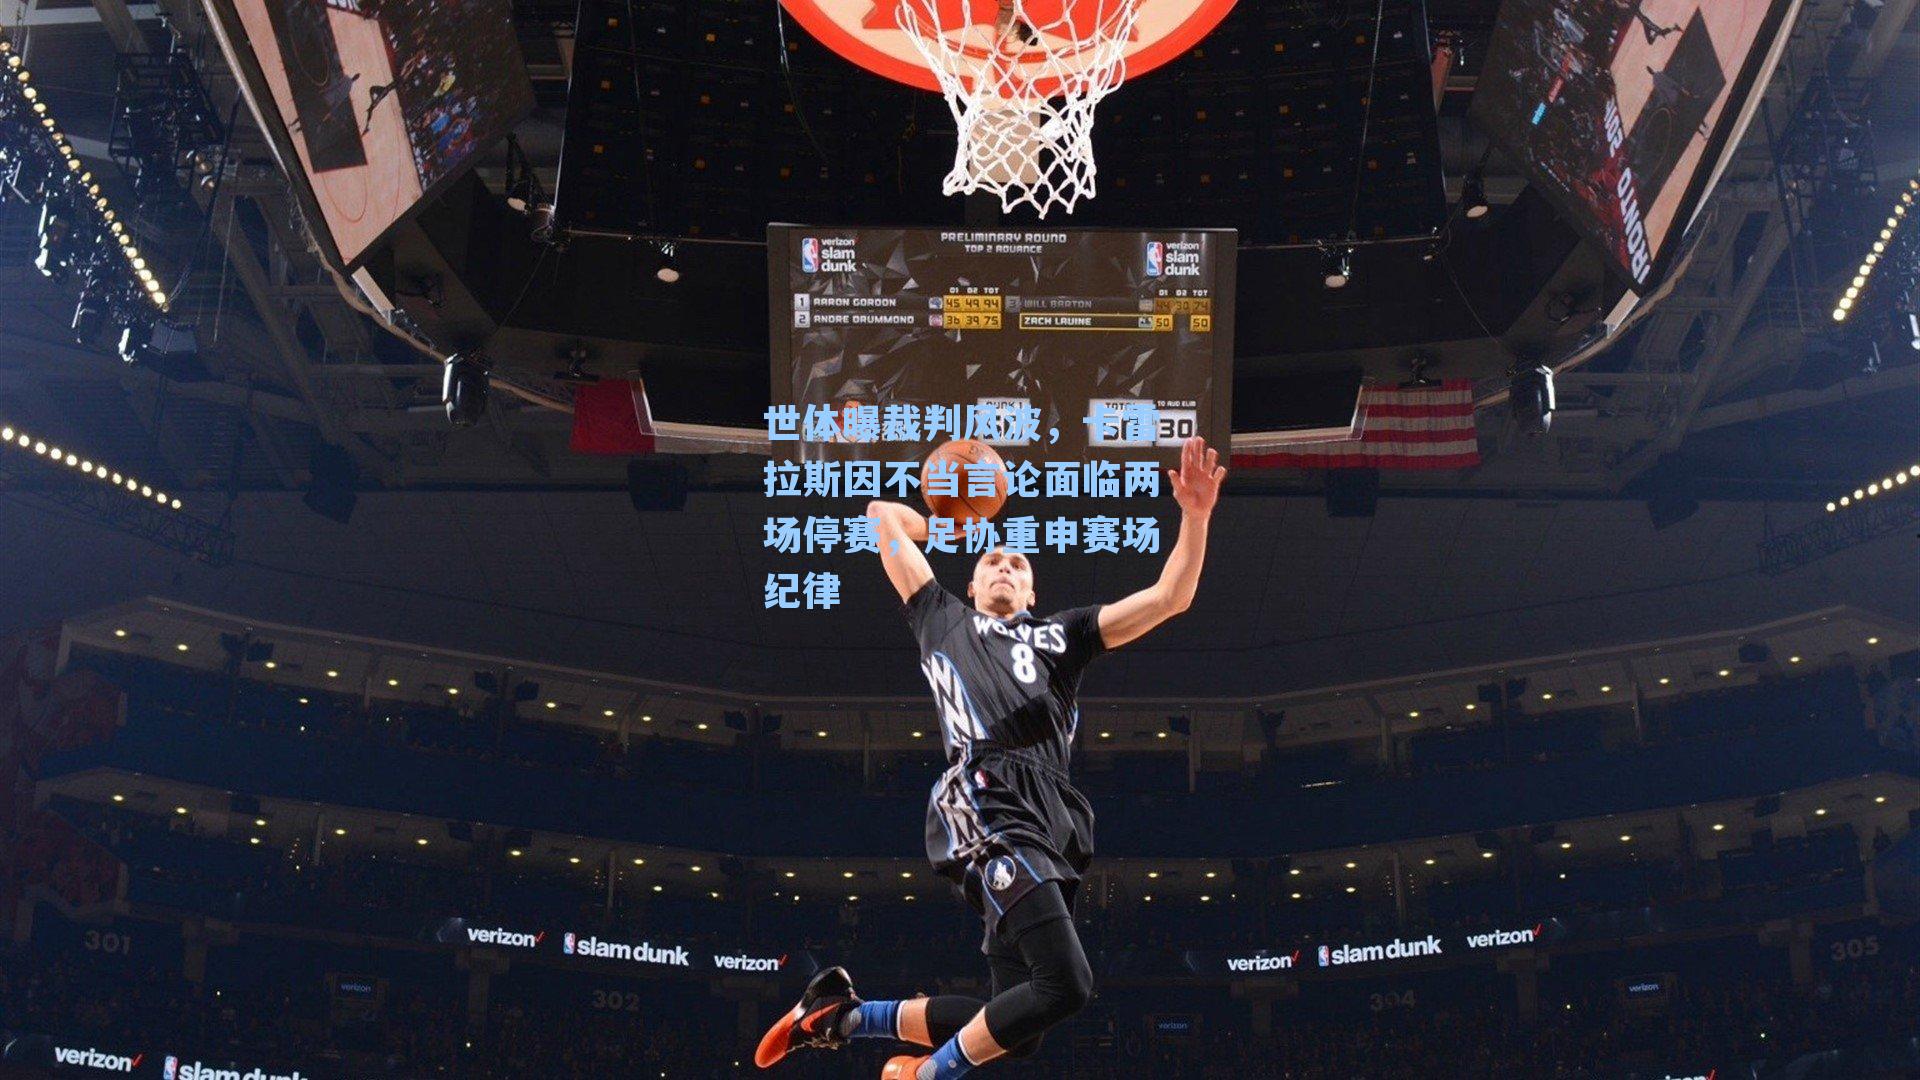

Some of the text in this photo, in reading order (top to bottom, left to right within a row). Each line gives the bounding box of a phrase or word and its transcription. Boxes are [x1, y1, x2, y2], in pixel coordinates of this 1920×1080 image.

[821, 238, 855, 246] verizon
[941, 232, 1067, 244] PRELIMINARY ROUND
[965, 245, 1042, 254] TOP 2 ADVANCE
[1165, 242, 1199, 250] verizon
[821, 247, 855, 259] slam
[1165, 251, 1199, 263] slam
[821, 260, 857, 272] dunk
[1165, 264, 1200, 276] dunk
[813, 298, 850, 306] AARON
[852, 298, 896, 306] GORDON
[946, 300, 999, 308] 45 49 94
[1024, 300, 1047, 308] WILL
[1050, 300, 1092, 308] BARTON
[813, 316, 850, 324] ANDRE
[852, 316, 914, 324] DRUMMOND
[966, 316, 980, 325] 39
[984, 316, 998, 325] 75
[1024, 317, 1092, 326] ZACH LAVINE
[1156, 318, 1170, 328] 50
[1193, 318, 1208, 328] 50
[1160, 418, 1193, 438] 30
[973, 616, 1067, 654] WOLVES
[1011, 643, 1037, 684] 8
[84, 929, 131, 956] 301
[467, 927, 536, 948] verizon
[1467, 929, 1534, 949] verizon
[577, 937, 689, 965] slam dunk
[1332, 935, 1442, 964] slam dunk
[1830, 935, 1880, 961] 305
[715, 955, 778, 970] verizon
[1227, 955, 1292, 972] verizon
[341, 982, 372, 993] verizon
[1628, 982, 1659, 993] verizon
[592, 990, 640, 1012] 302
[55, 1047, 131, 1071] verizon
[179, 1062, 240, 1080] slam
